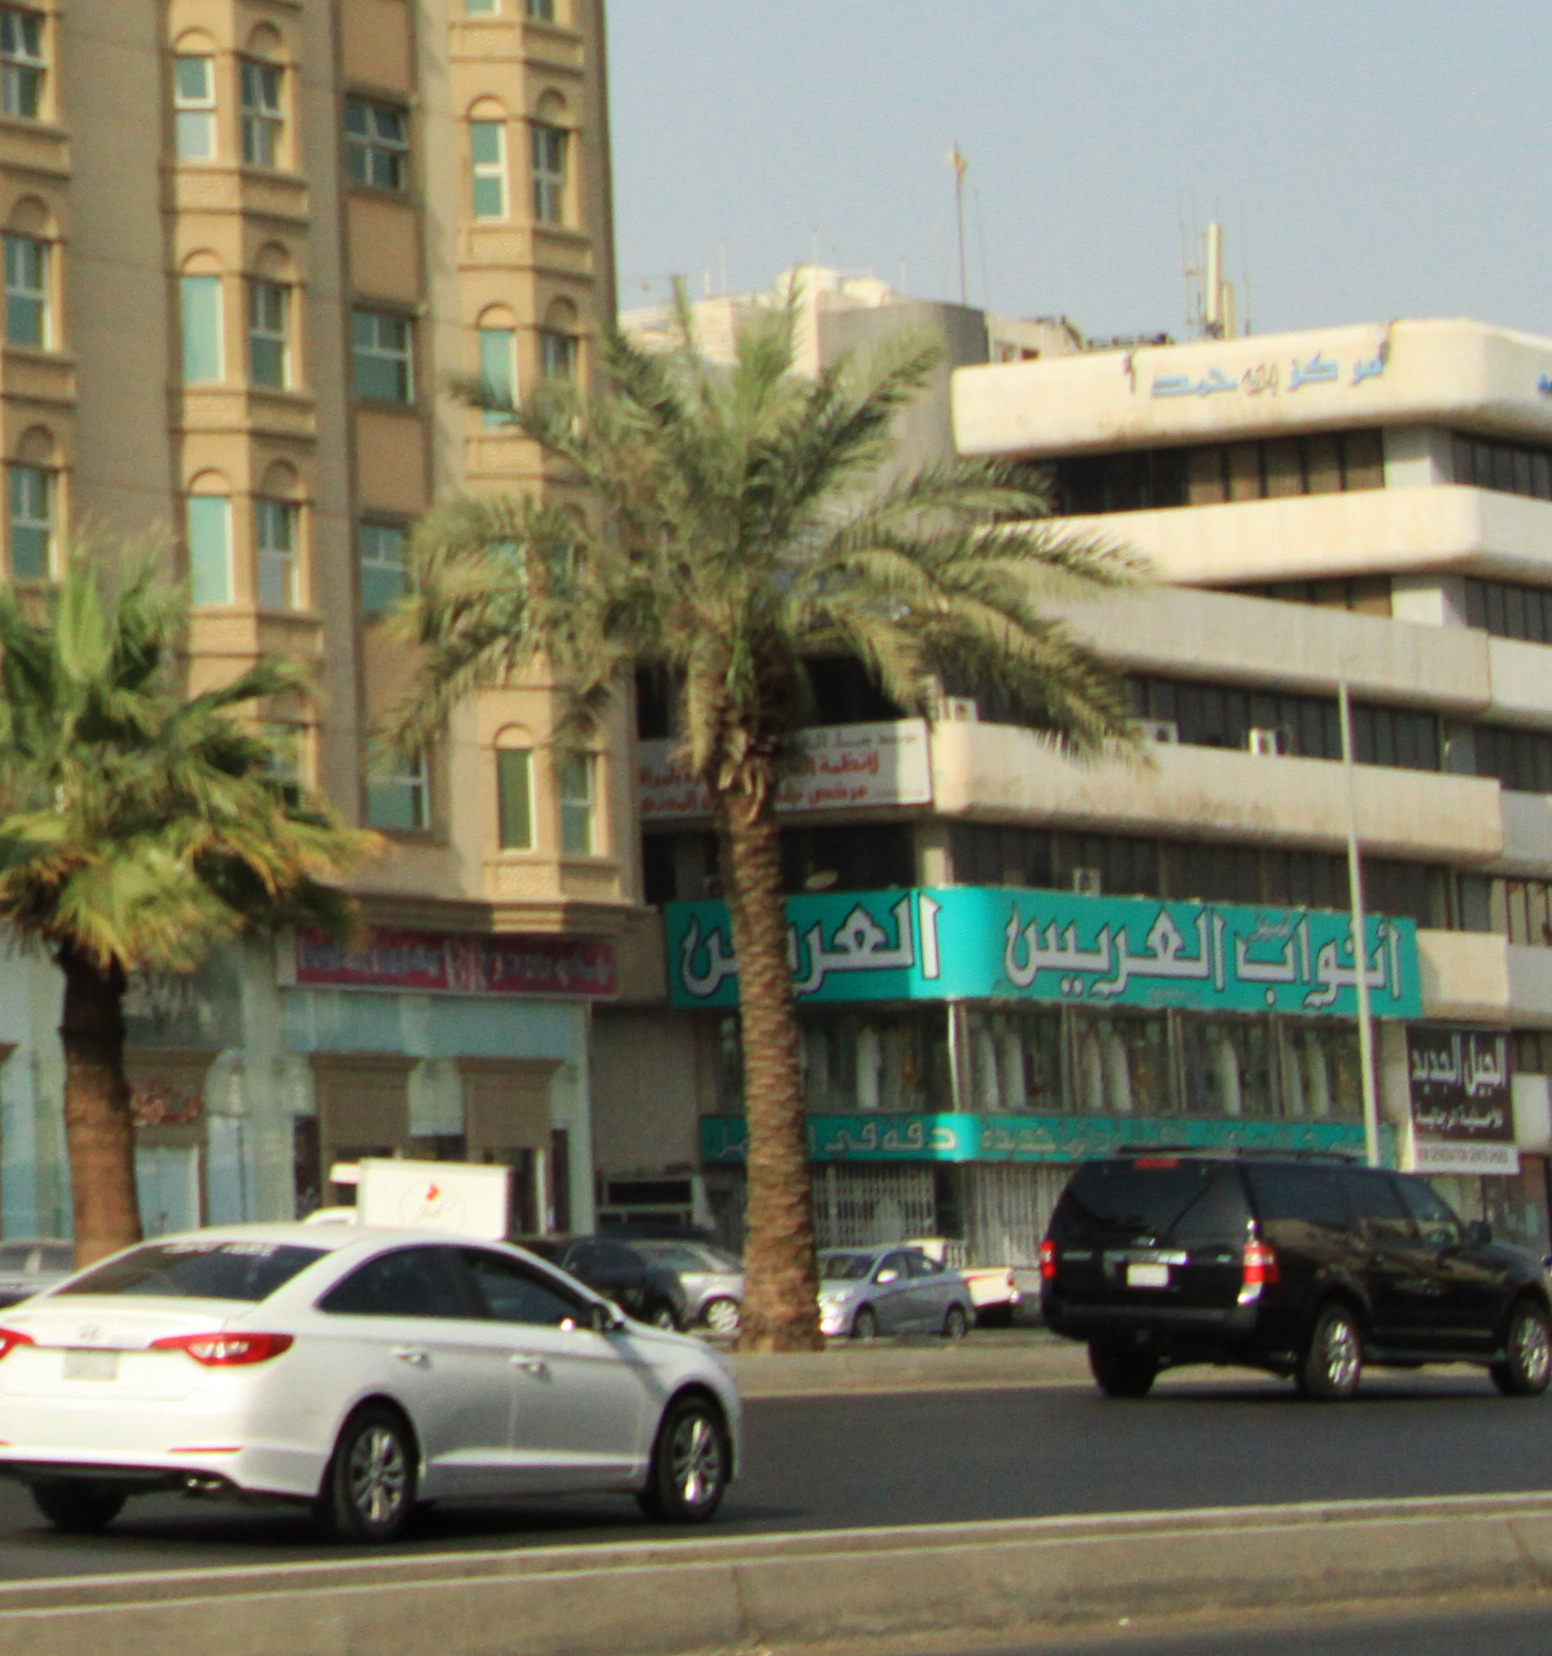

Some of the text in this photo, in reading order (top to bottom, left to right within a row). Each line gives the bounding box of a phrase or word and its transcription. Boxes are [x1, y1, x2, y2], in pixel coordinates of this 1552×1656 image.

[682, 892, 942, 998] العرس
[1003, 900, 1227, 1000] العريس
[1411, 1032, 1507, 1096] الجيل الجديد
